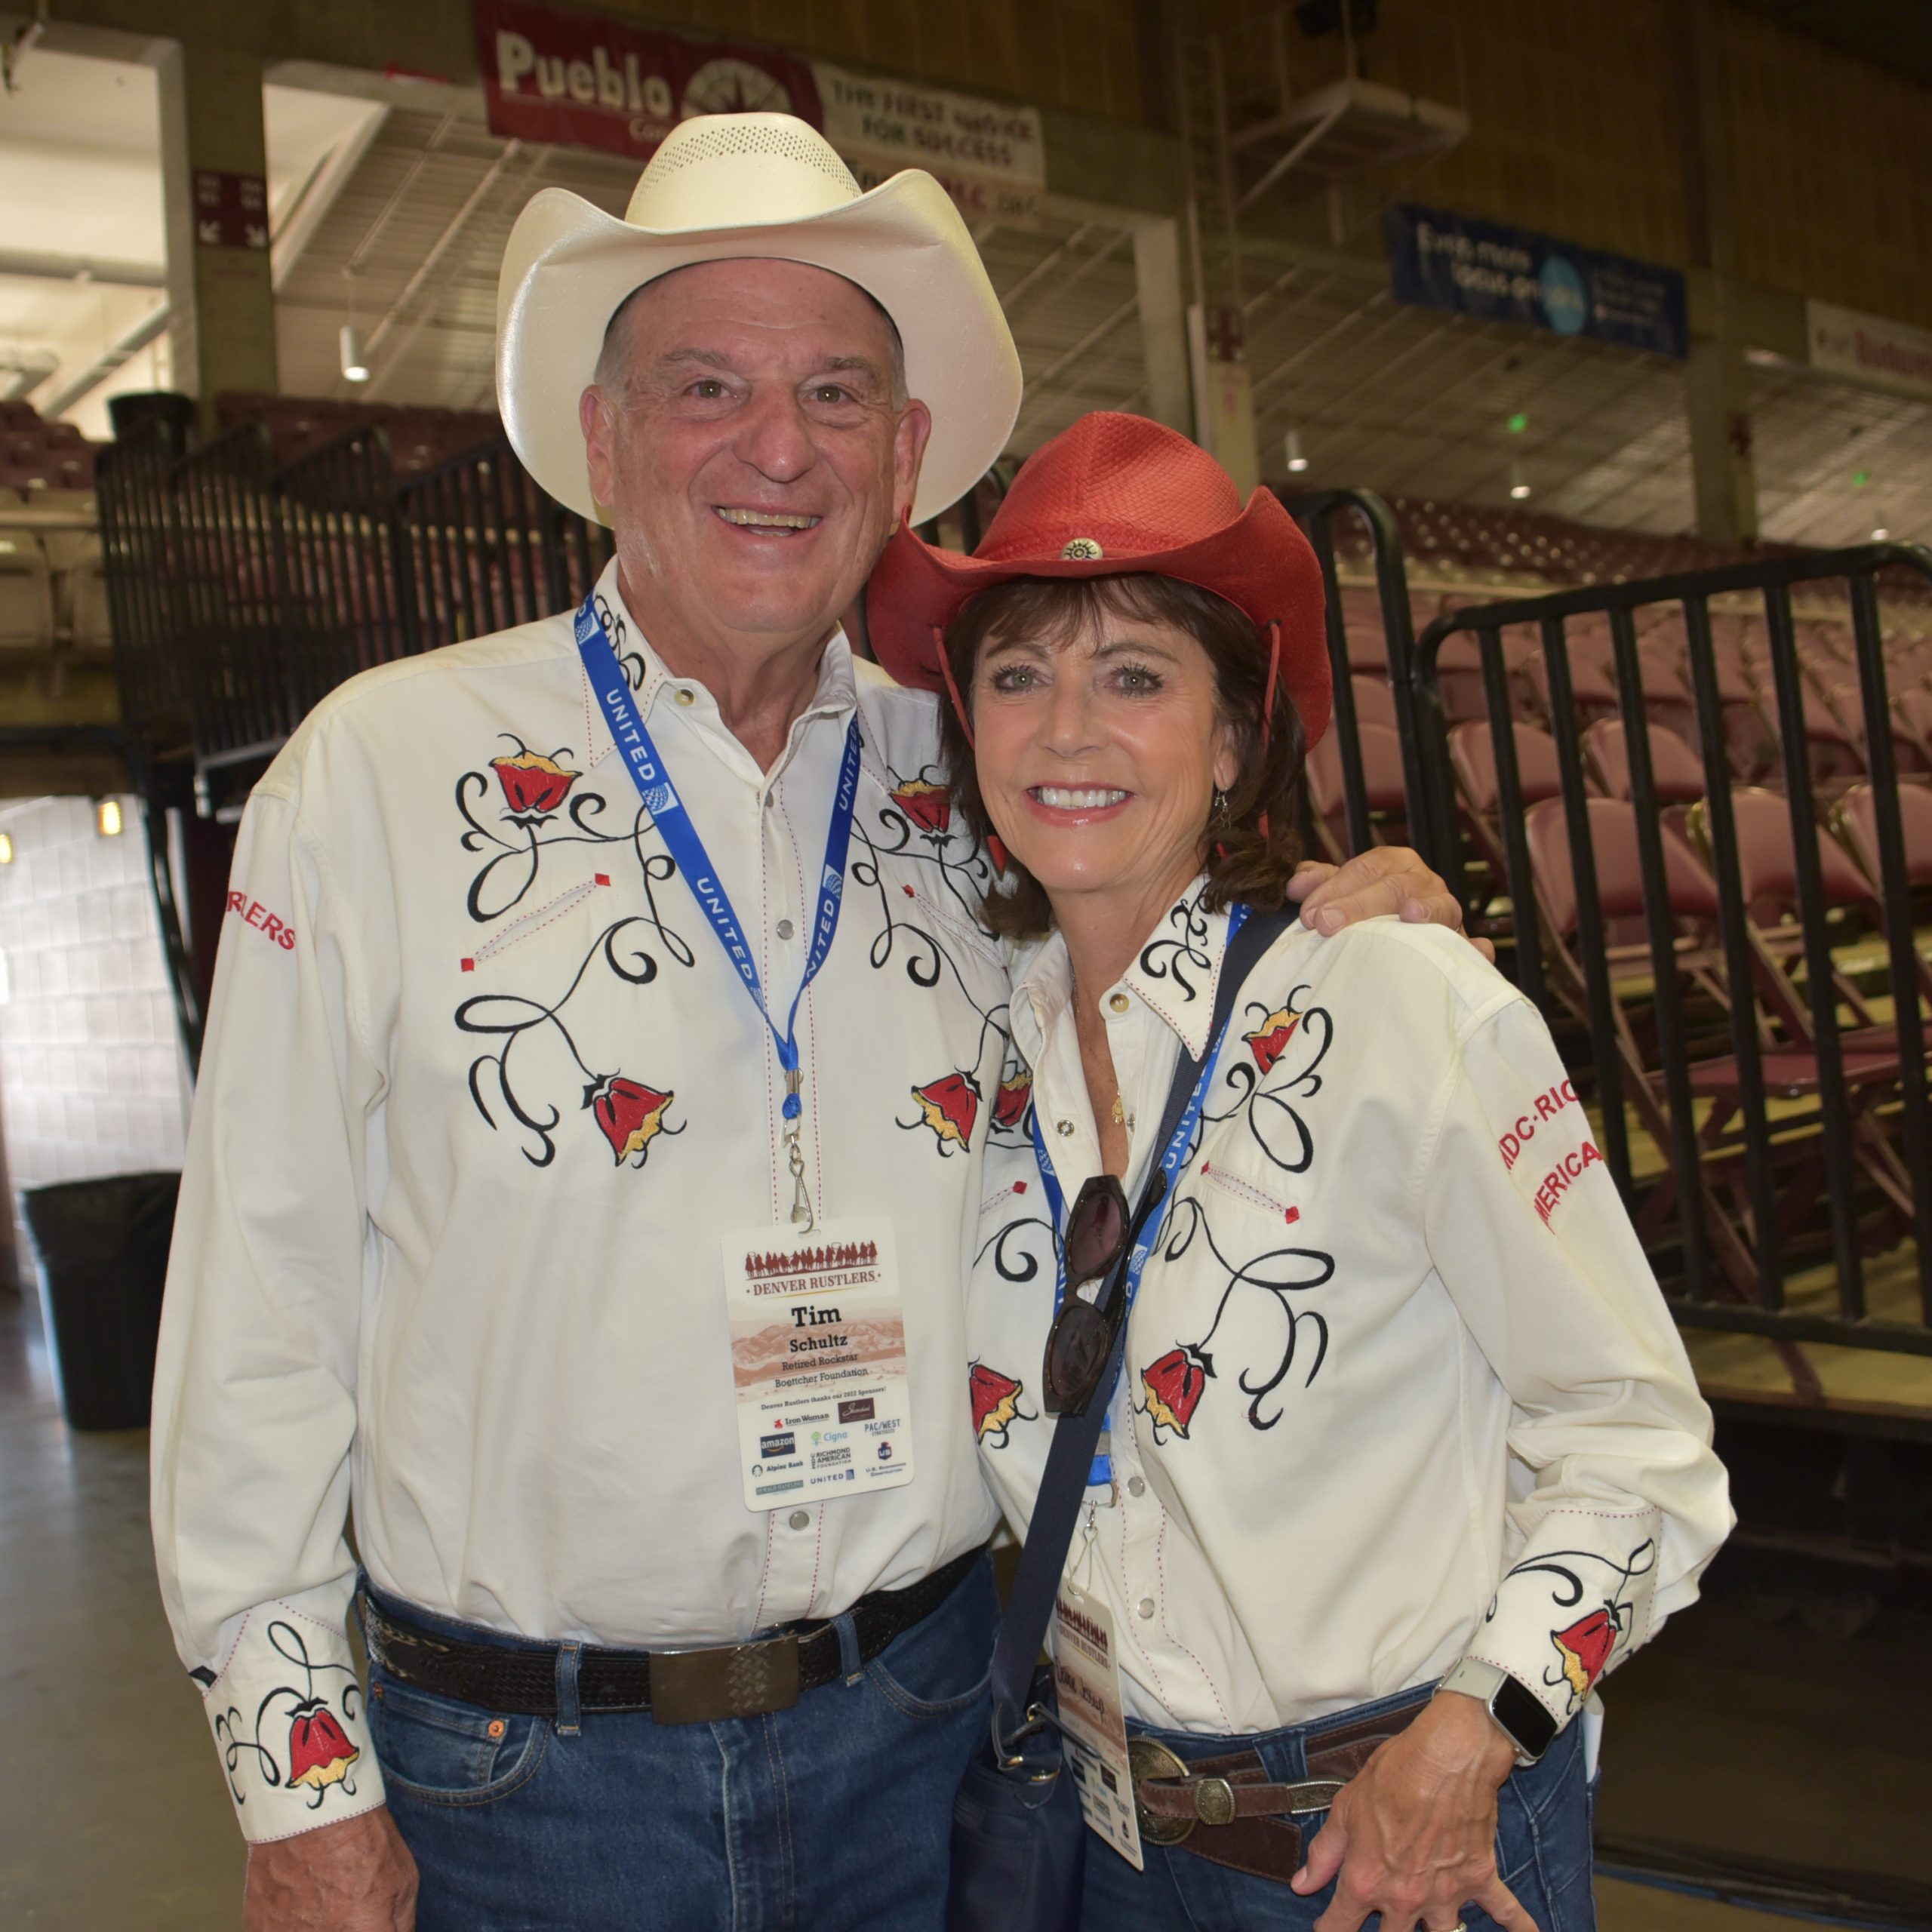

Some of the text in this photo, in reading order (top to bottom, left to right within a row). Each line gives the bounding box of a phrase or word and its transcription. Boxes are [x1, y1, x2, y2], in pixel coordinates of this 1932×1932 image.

[497, 29, 672, 118] Pueblo
[883, 91, 944, 121] FIRST
[863, 115, 906, 143] FOR
[606, 688, 656, 781] UNITED
[697, 877, 752, 980] UNITED
[807, 899, 834, 979] NITED
[753, 1271, 875, 1297] DENVER RUSTLERS
[791, 1306, 842, 1328] Tim
[789, 1334, 848, 1353] Schultz
[782, 1353, 859, 1371] Retired Rockstar
[775, 1367, 869, 1389] Boettcher Foundation
[761, 1402, 783, 1411] Denver
[785, 1398, 810, 1407] Rustlers
[811, 1395, 831, 1404] thanks
[785, 1413, 829, 1426] Iron Woman
[864, 1419, 900, 1433] PAC/WEST
[761, 1435, 795, 1449] amazon
[823, 1430, 848, 1443] Cigna
[816, 1447, 851, 1457] RICHMOND
[817, 1454, 851, 1464] AMERICAN
[766, 1463, 787, 1474] Alpine
[817, 1460, 852, 1469] FOUNDATION
[810, 1473, 844, 1484] UNITED
